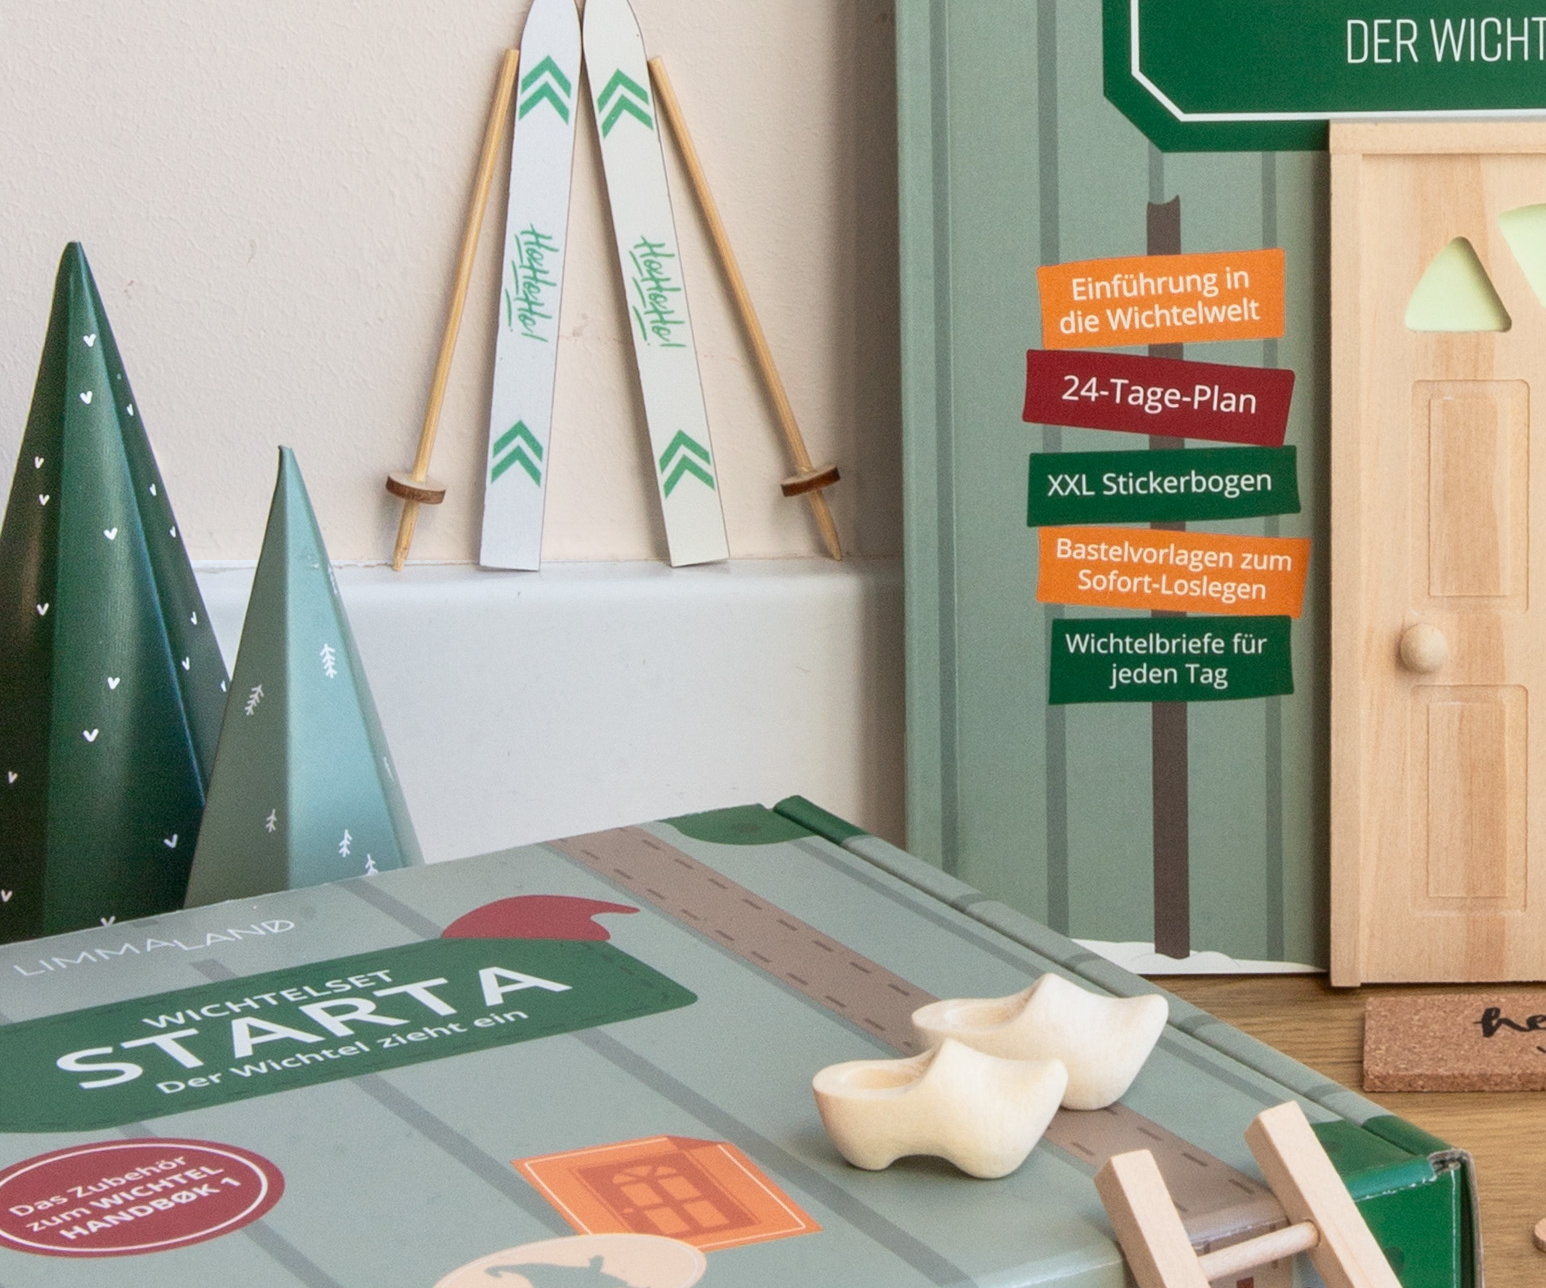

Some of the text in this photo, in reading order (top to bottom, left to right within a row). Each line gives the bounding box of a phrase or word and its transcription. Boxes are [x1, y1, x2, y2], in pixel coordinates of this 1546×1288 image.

[1347, 18, 1419, 63] DER
[1071, 266, 1250, 302] Einführung in
[1059, 298, 1260, 334] die Wichtelwelt
[1061, 375, 1257, 414] 24-Tage-Plan
[1047, 470, 1272, 498] XXL Stickerbogen
[1056, 538, 1292, 572] Bastelvorlagen zum
[1078, 569, 1267, 603] Sofort-Loslegen
[1065, 633, 1268, 654] Wichtelbriefe für
[1109, 663, 1229, 689] jeden Tag
[142, 969, 391, 1029] WICHTELSET
[56, 966, 573, 1090] STARTA
[156, 1008, 529, 1094] Der Wichtel zieht ein
[9, 1156, 188, 1217] Das Zubehör
[25, 1166, 225, 1233] zum WICHTEL
[59, 1176, 242, 1240] HANDBØK 1
